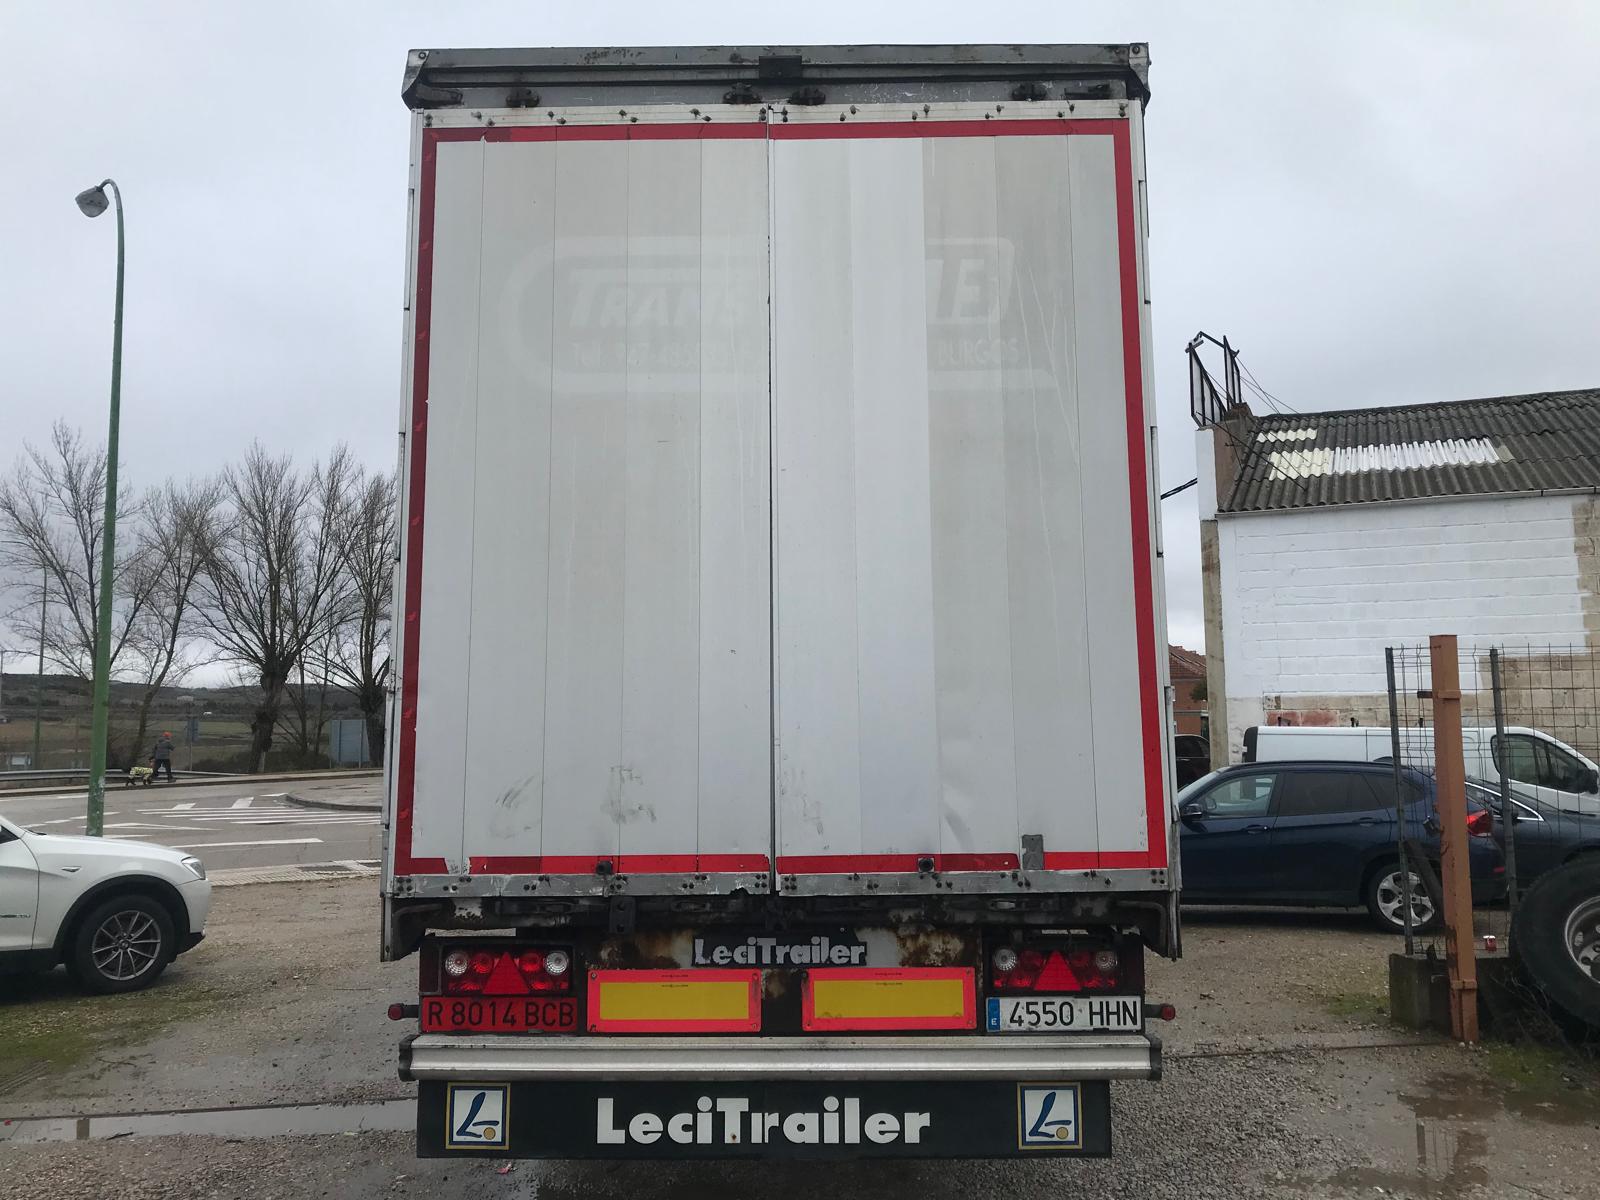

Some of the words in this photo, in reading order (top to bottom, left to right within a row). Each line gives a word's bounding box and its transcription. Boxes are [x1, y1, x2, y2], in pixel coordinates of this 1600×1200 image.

[694, 936, 865, 965] LeciTrailer
[427, 1002, 443, 1025] R
[451, 1001, 517, 1027] 8014
[524, 1002, 573, 1027] BCB
[1009, 1001, 1074, 1026] 4550
[1089, 1000, 1138, 1026] HHN
[596, 1096, 930, 1145] LeciTrailer
